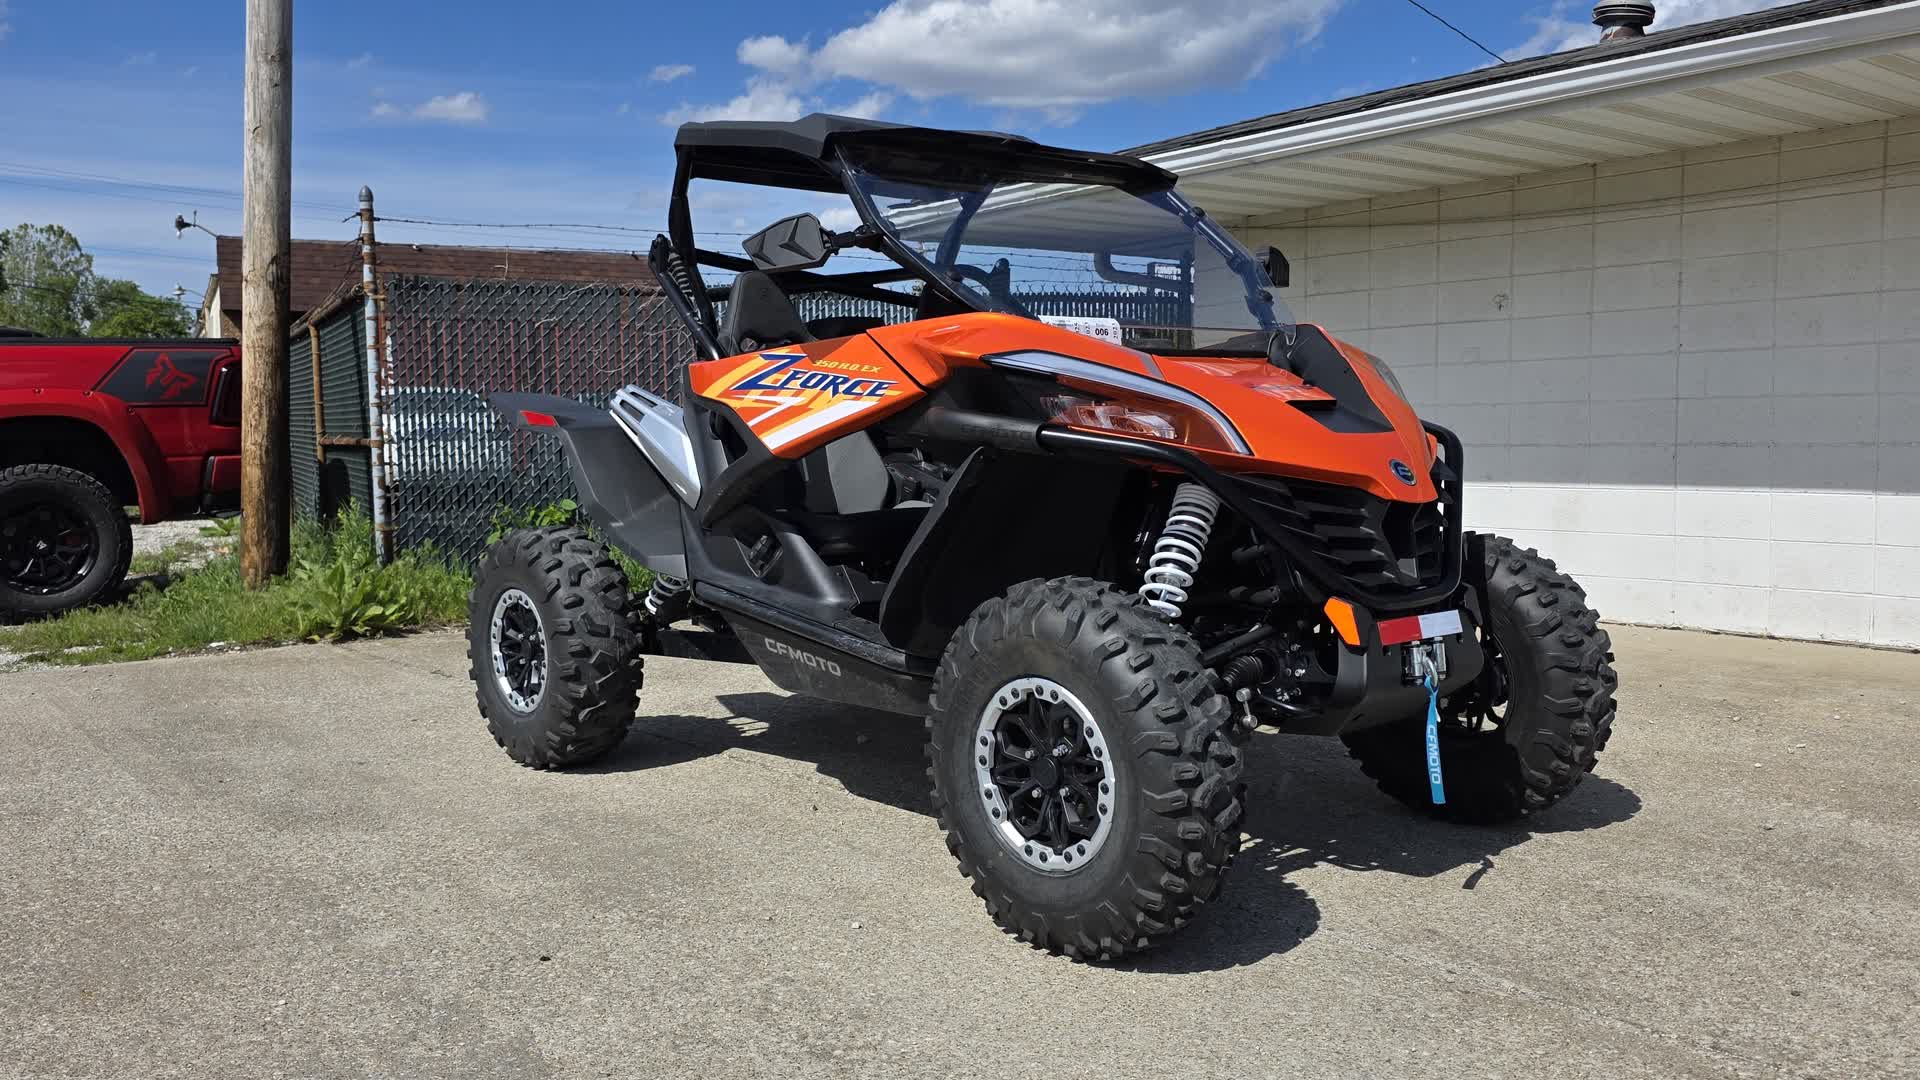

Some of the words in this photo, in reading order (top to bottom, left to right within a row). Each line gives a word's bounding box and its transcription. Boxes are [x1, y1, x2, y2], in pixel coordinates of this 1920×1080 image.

[1094, 328, 1109, 336] 006
[861, 364, 883, 373] EX
[764, 637, 842, 677] CFMOTO
[1428, 725, 1441, 784] CFMOTO
